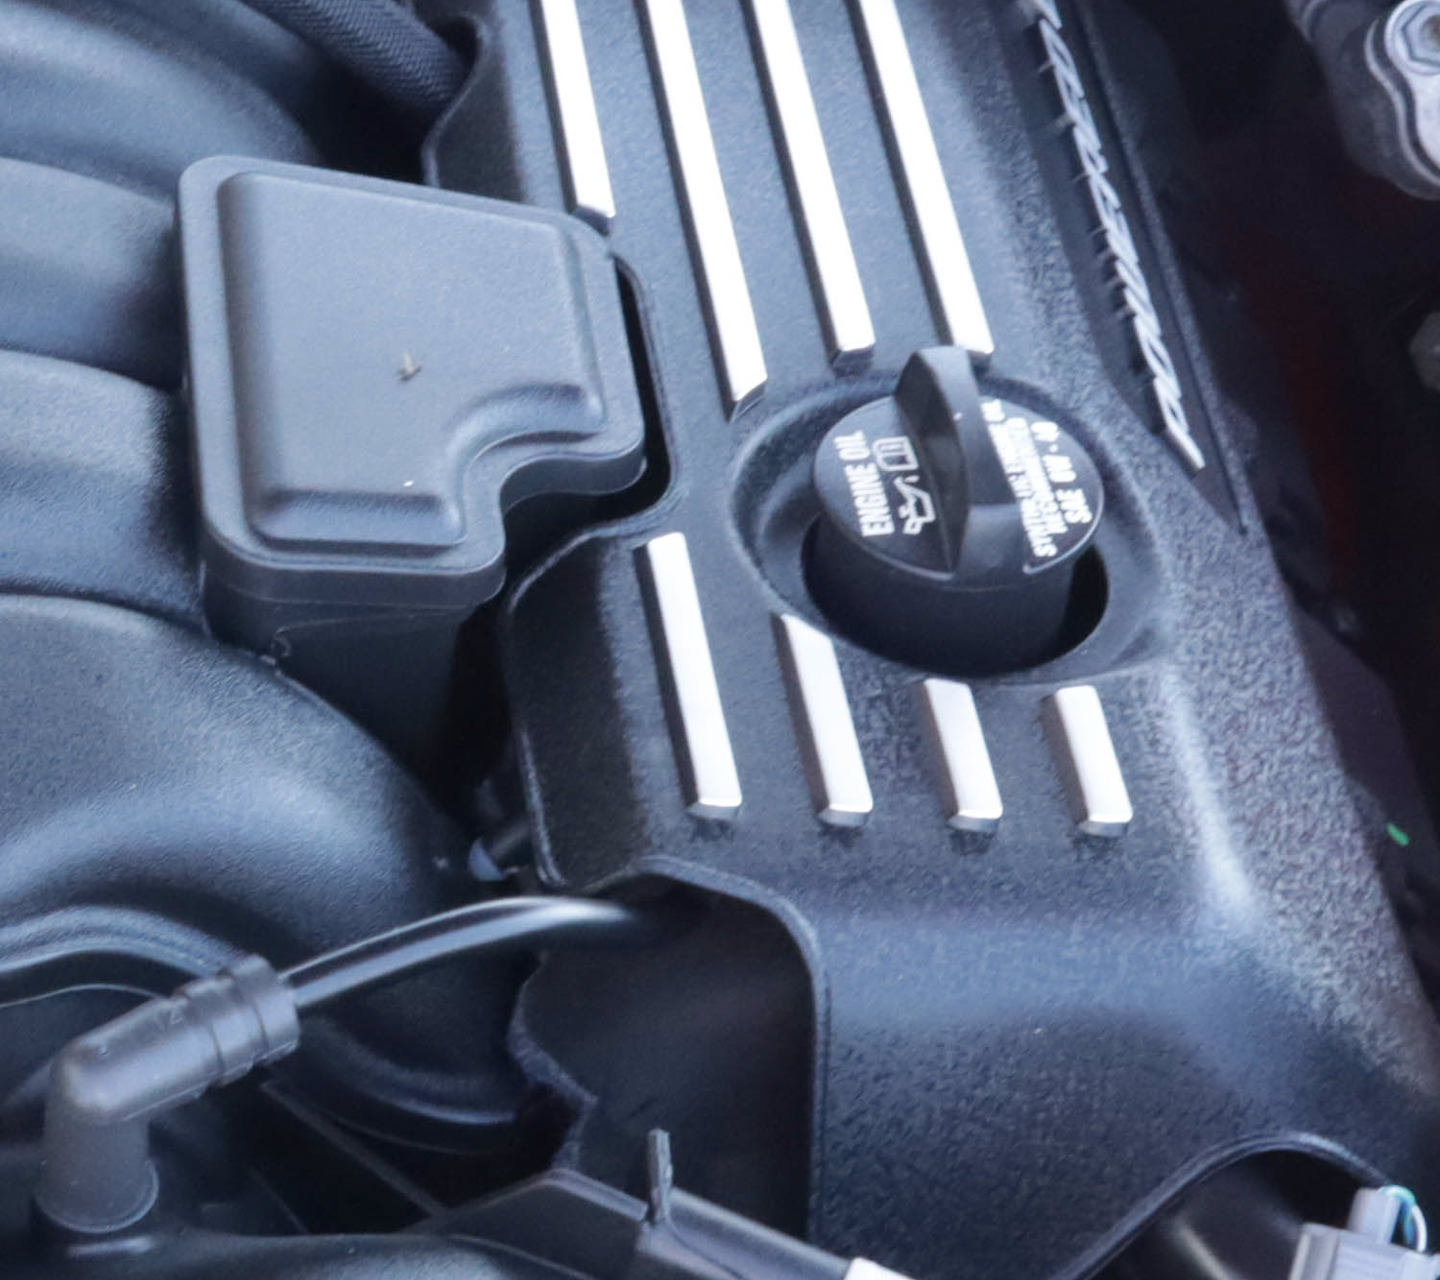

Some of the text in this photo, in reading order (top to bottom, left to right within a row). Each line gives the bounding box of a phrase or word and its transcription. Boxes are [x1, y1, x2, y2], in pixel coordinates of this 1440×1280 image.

[834, 429, 895, 538] ENGINE OIL
[1053, 488, 1092, 523] SAE
